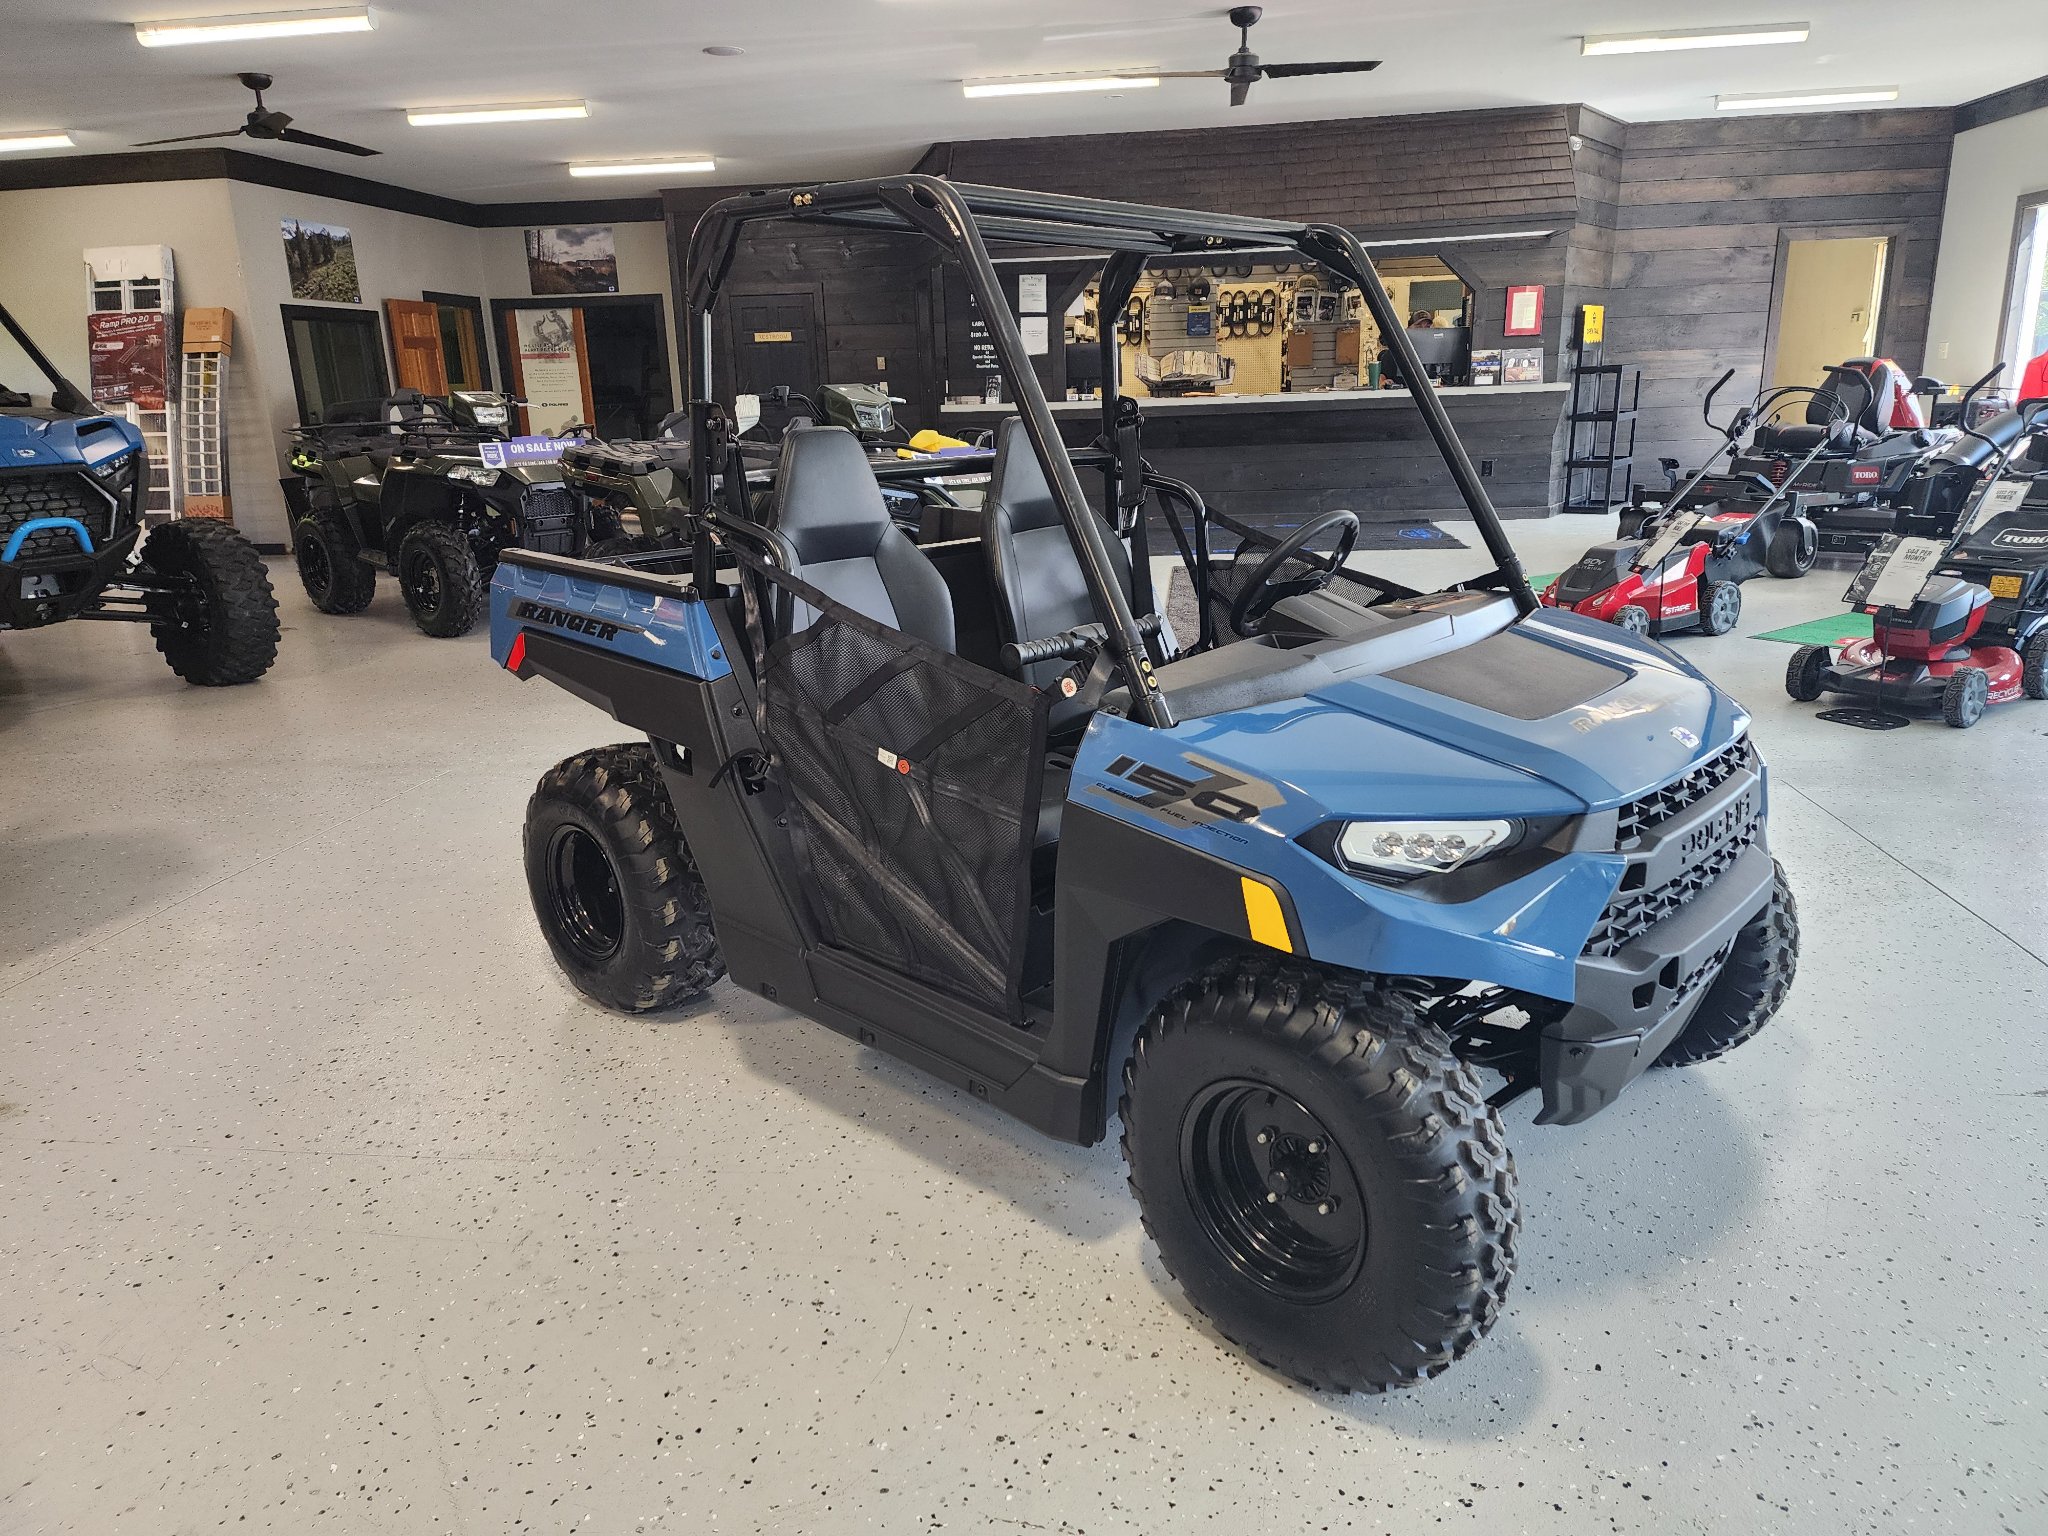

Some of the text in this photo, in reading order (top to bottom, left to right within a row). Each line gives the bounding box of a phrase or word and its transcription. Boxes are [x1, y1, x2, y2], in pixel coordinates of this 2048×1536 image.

[99, 314, 149, 329] Ramp PRO 2.0
[510, 443, 525, 454] ON
[526, 442, 552, 453] SALE
[1854, 471, 1877, 479] TORO
[516, 601, 619, 641] RANGER
[1104, 754, 1261, 824] 150
[1160, 806, 1188, 821] FUEL
[1192, 818, 1248, 845] INJECTION
